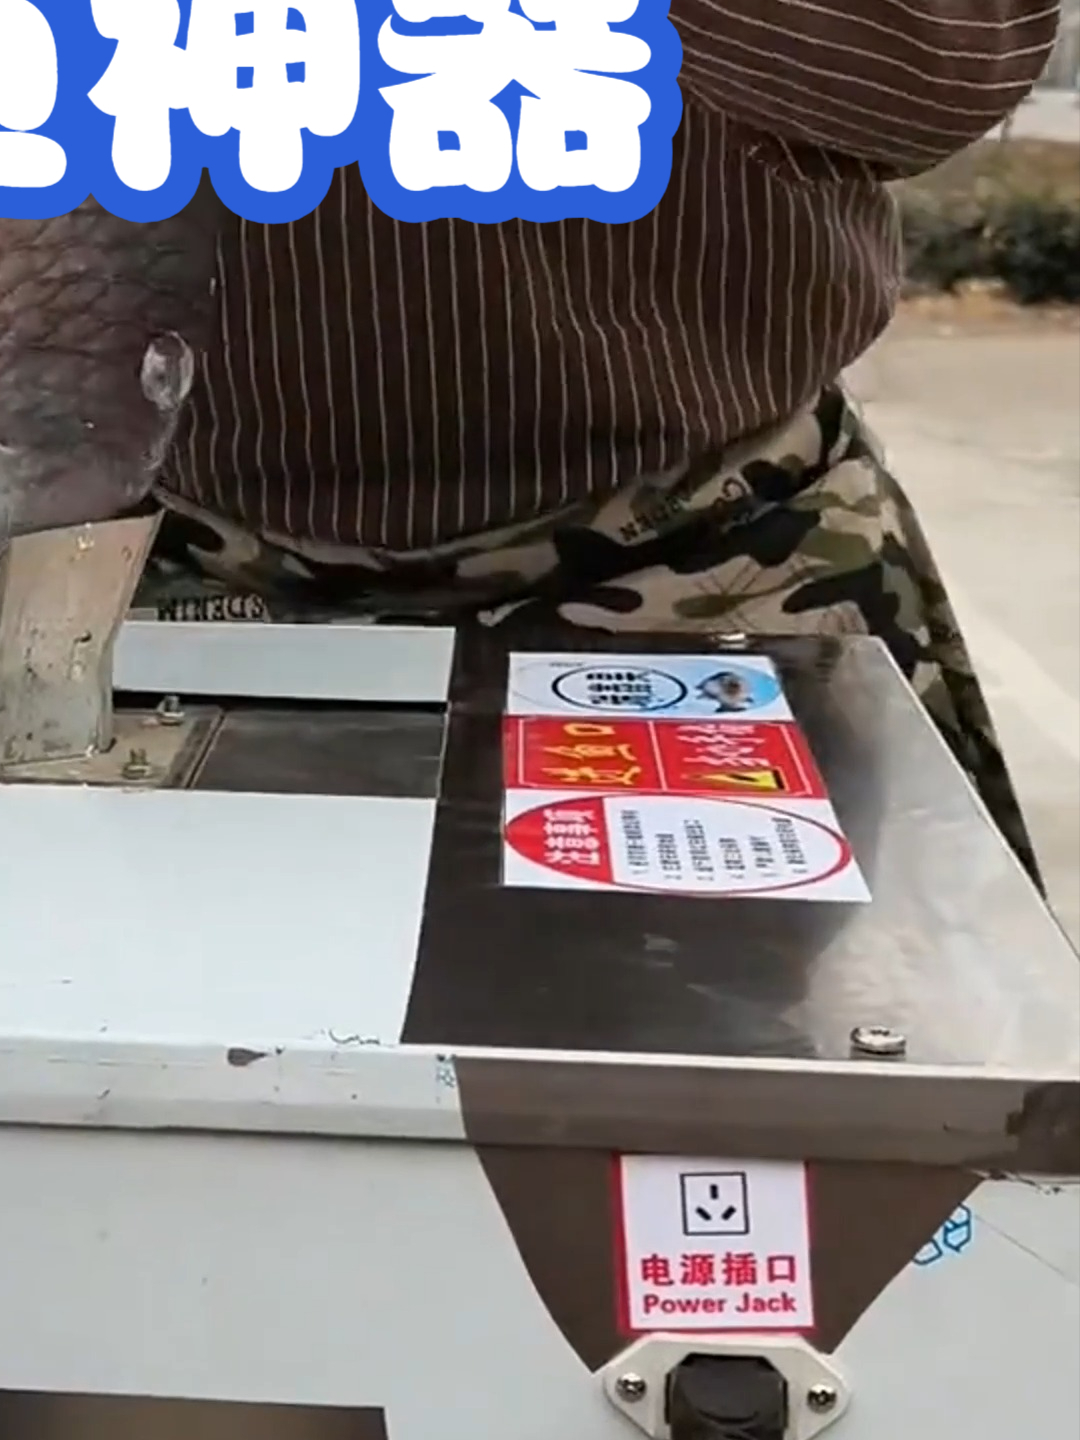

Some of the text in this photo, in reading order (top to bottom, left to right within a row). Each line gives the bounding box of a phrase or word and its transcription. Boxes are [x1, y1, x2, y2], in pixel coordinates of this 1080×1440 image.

[542, 809, 601, 865] 注意事项
[640, 1251, 796, 1287] 电源插口
[643, 1291, 797, 1315] Power Jack
